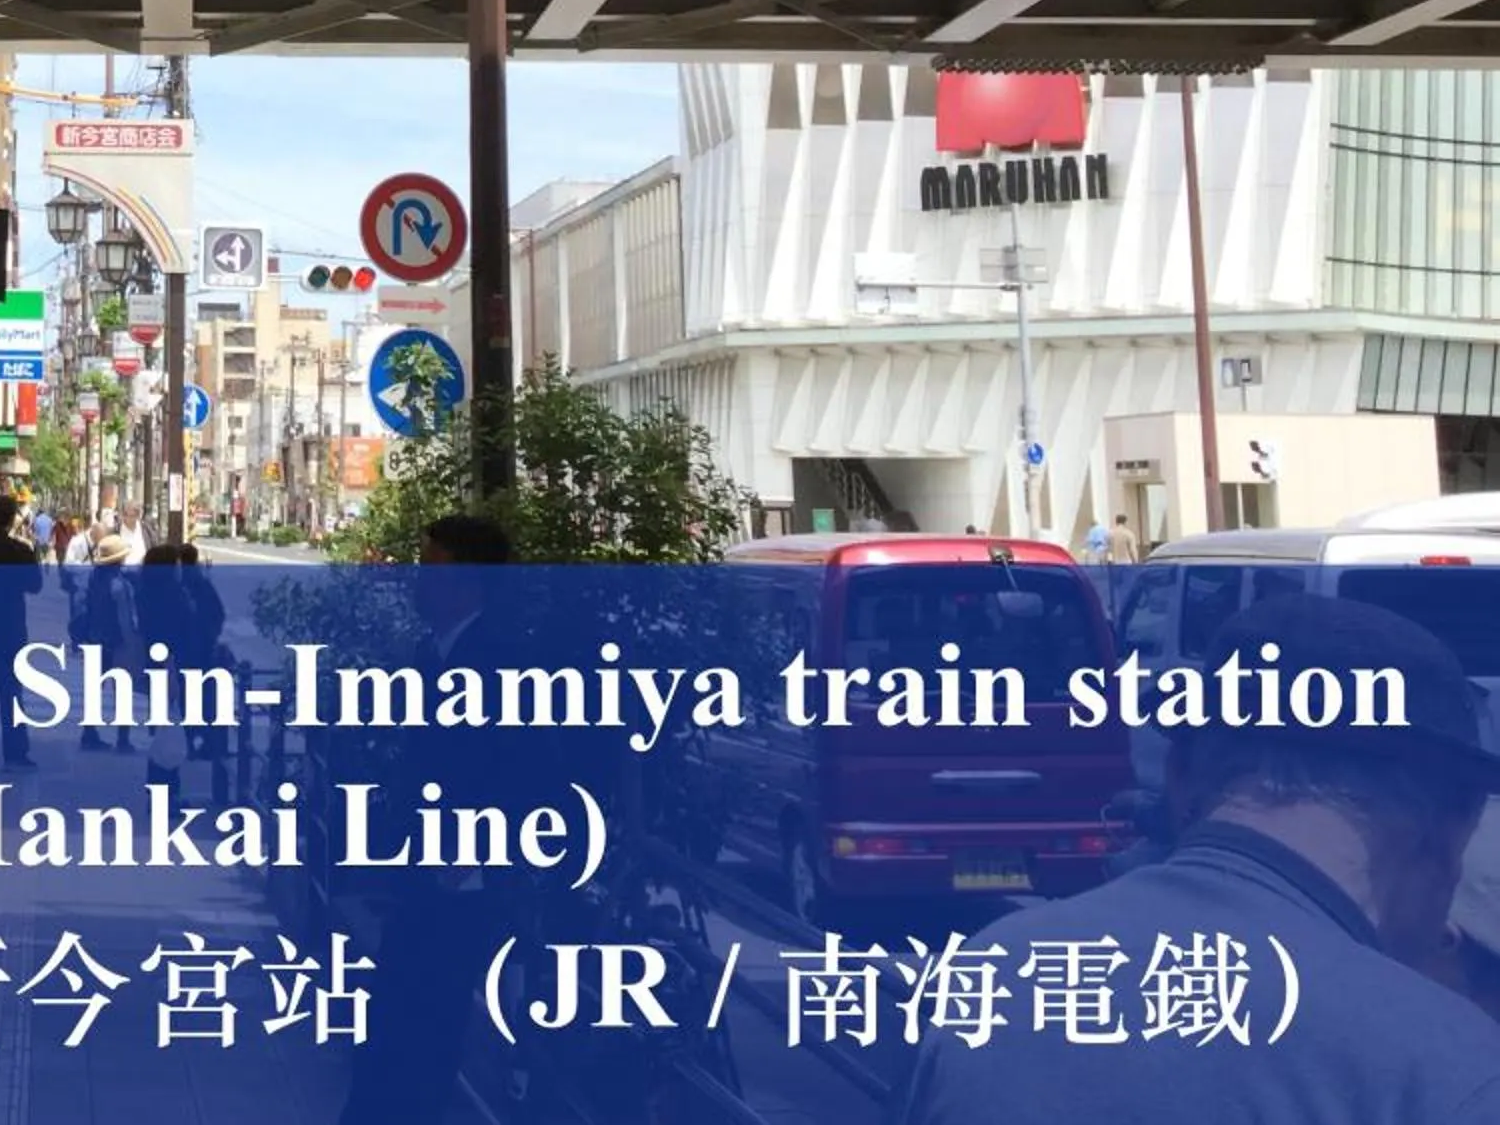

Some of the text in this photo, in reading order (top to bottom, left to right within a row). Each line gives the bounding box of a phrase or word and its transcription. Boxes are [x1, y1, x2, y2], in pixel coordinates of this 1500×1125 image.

[60, 125, 178, 148] 新今宮商店会
[920, 153, 1109, 212] MARUHAN
